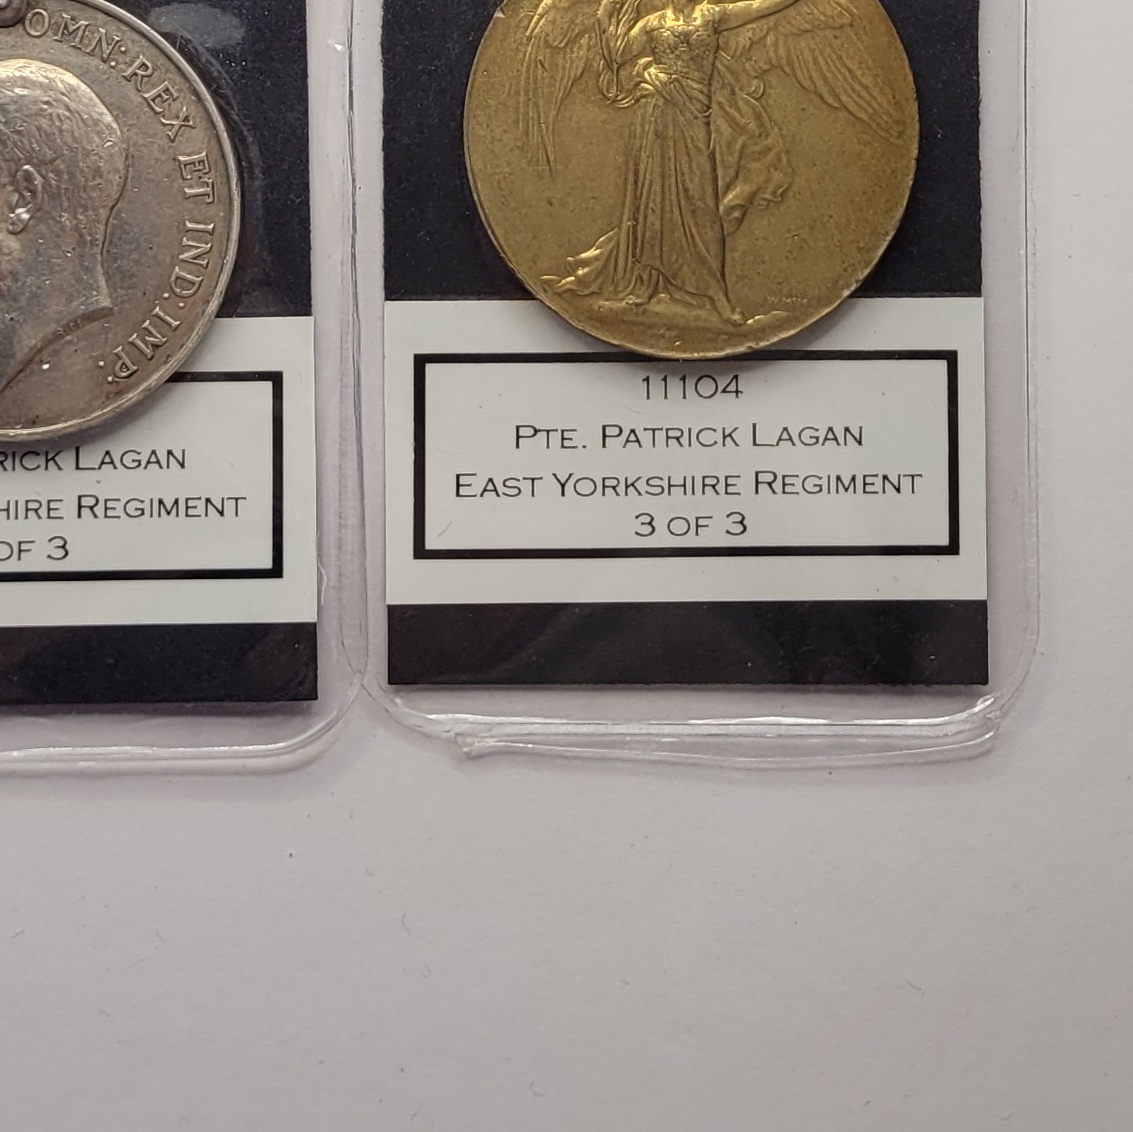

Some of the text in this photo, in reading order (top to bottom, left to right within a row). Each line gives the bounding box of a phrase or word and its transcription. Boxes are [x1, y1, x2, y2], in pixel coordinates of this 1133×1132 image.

[120, 55, 197, 143] REX
[178, 150, 215, 205] ET
[641, 374, 744, 401] 11104
[514, 422, 864, 450] PTE. PATRICK LAGAN
[74, 445, 187, 472] LAGAN
[454, 470, 924, 498] EAST YORKSHIRE REGIMENT
[76, 493, 248, 520] REGIMENT
[634, 511, 748, 538] 3 OF 3
[46, 535, 71, 562] 3
